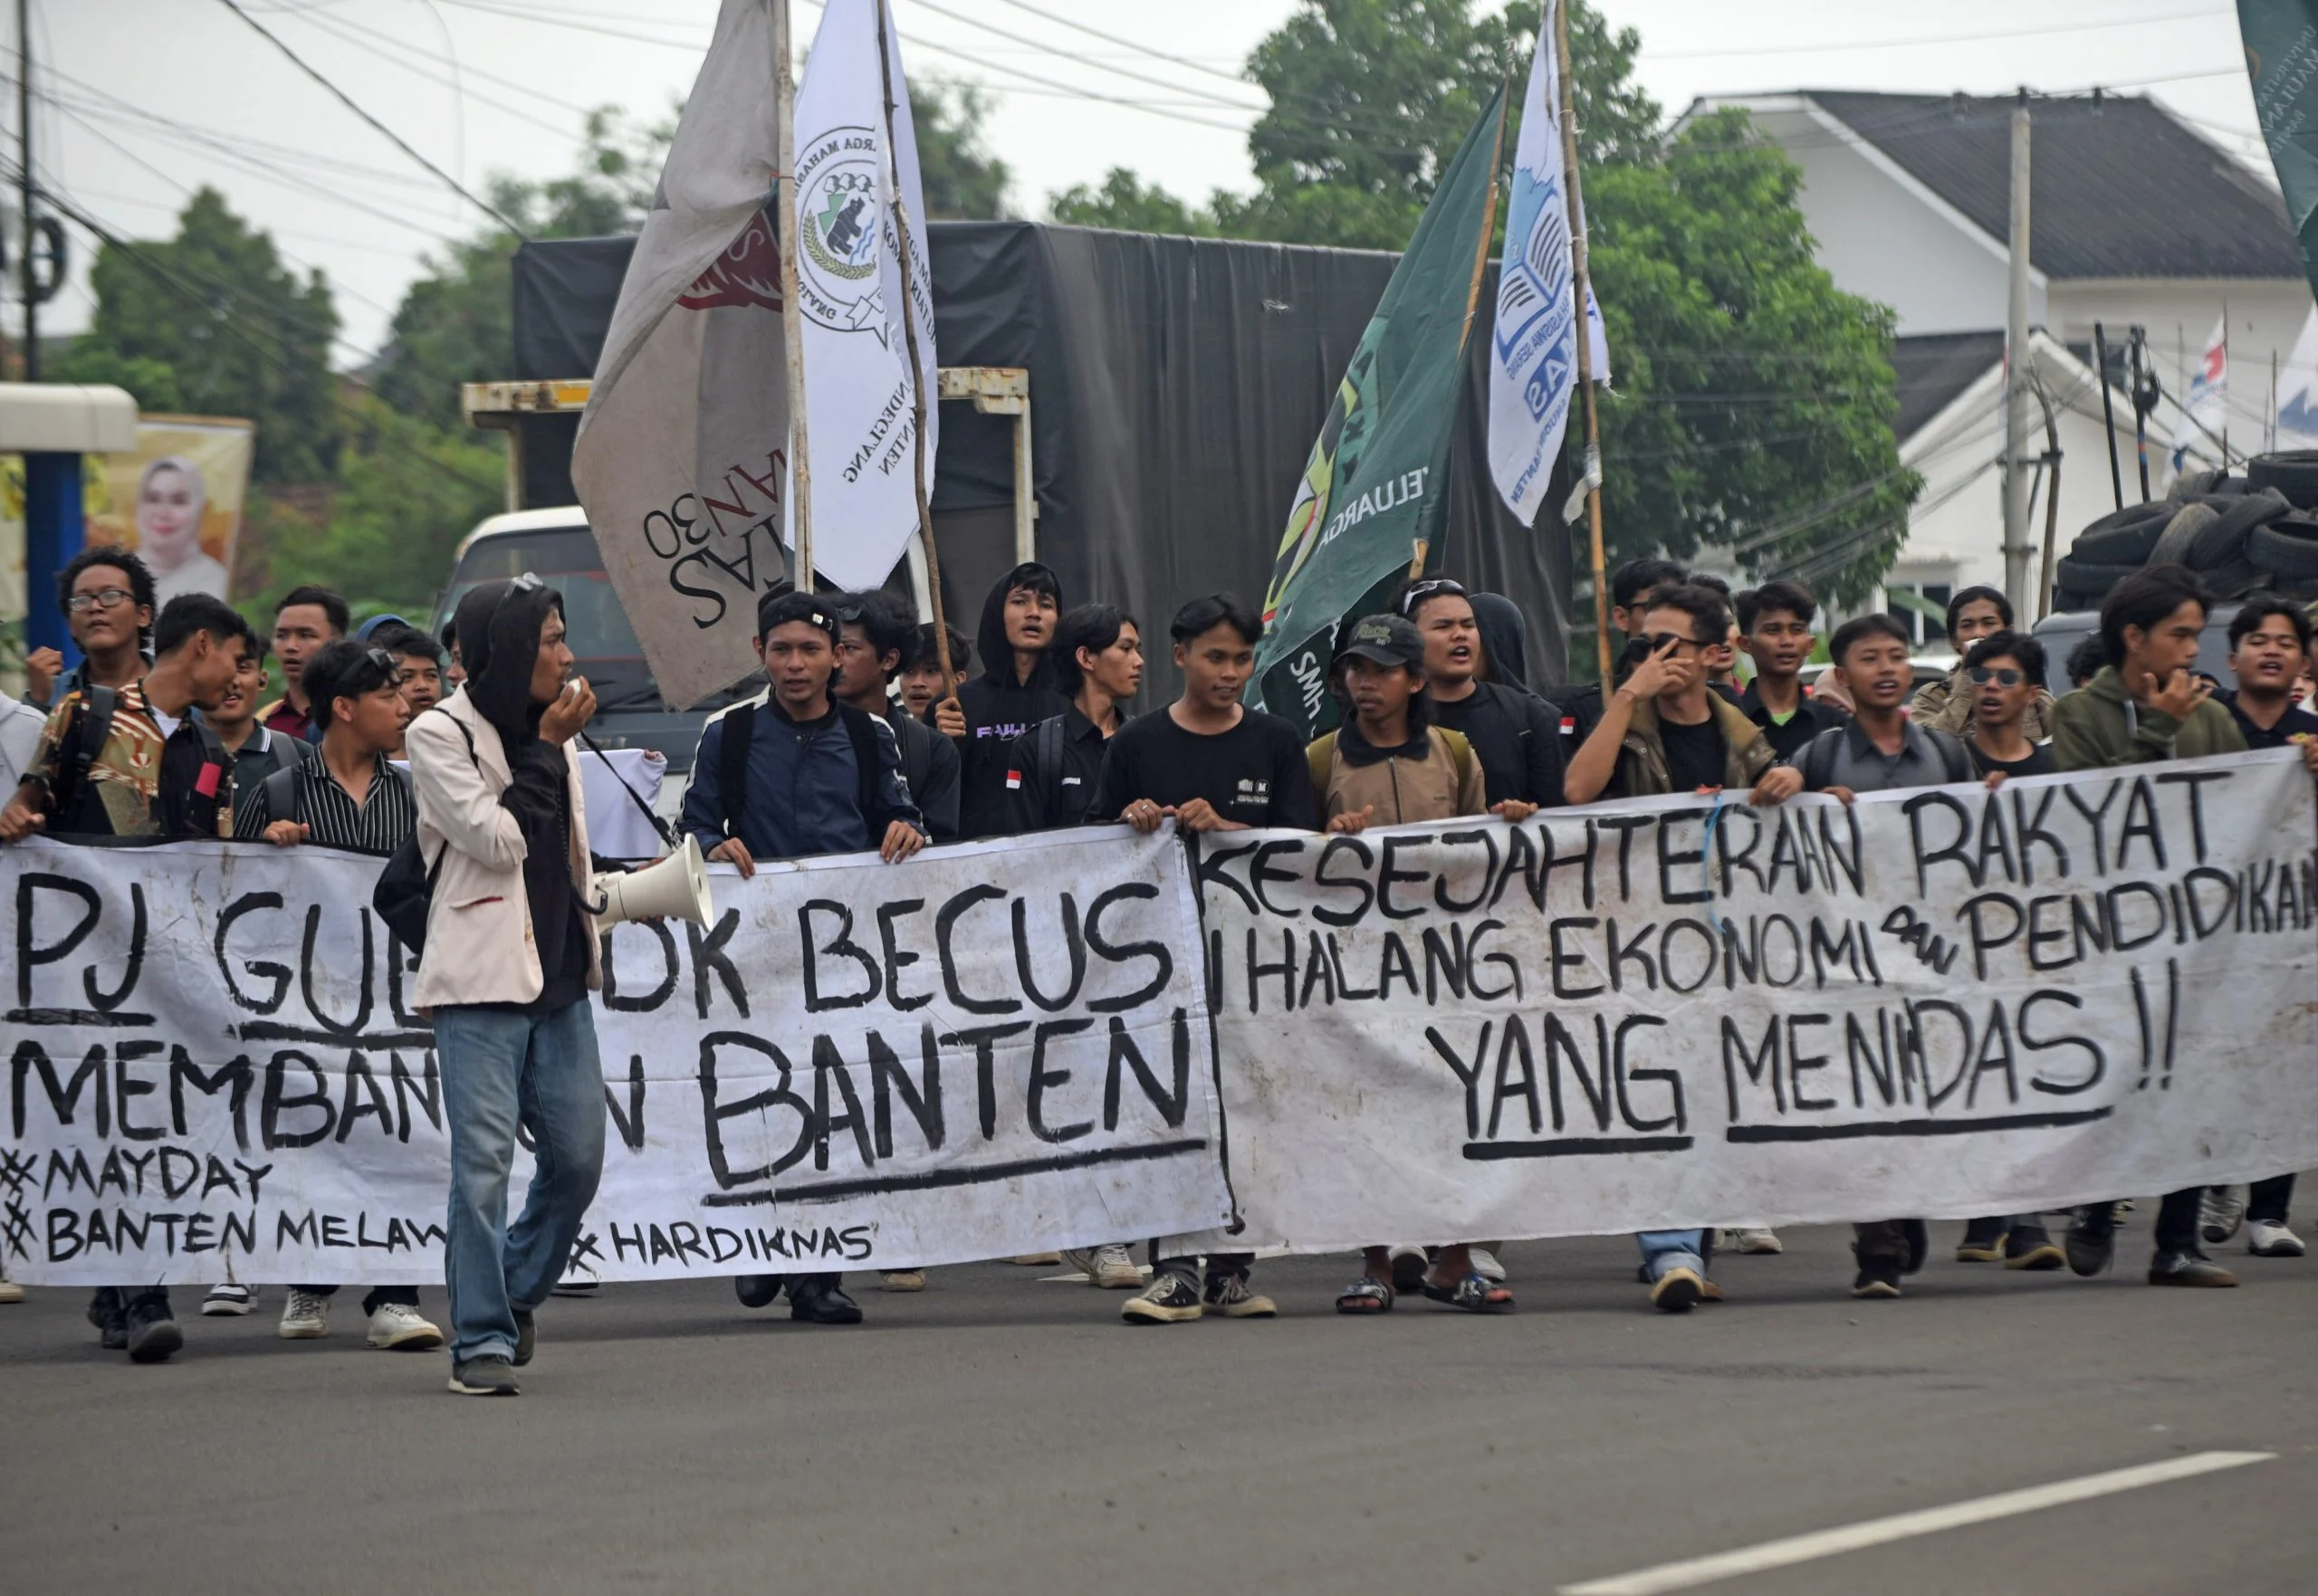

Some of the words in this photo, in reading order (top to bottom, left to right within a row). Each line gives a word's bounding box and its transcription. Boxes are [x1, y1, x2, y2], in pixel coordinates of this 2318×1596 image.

[1290, 651, 1325, 720] SMH
[1902, 771, 2234, 898] RAKYAT
[16, 872, 148, 1012] PJ
[798, 884, 1173, 1016] BECUS
[1247, 919, 1524, 1015] HALANG
[1550, 913, 1884, 999] EKONOMI
[11, 1040, 646, 1156] MEMBANN
[697, 1007, 1191, 1191] BANTEN
[1424, 1011, 1688, 1140] YANG
[277, 1208, 446, 1257] MELAW
